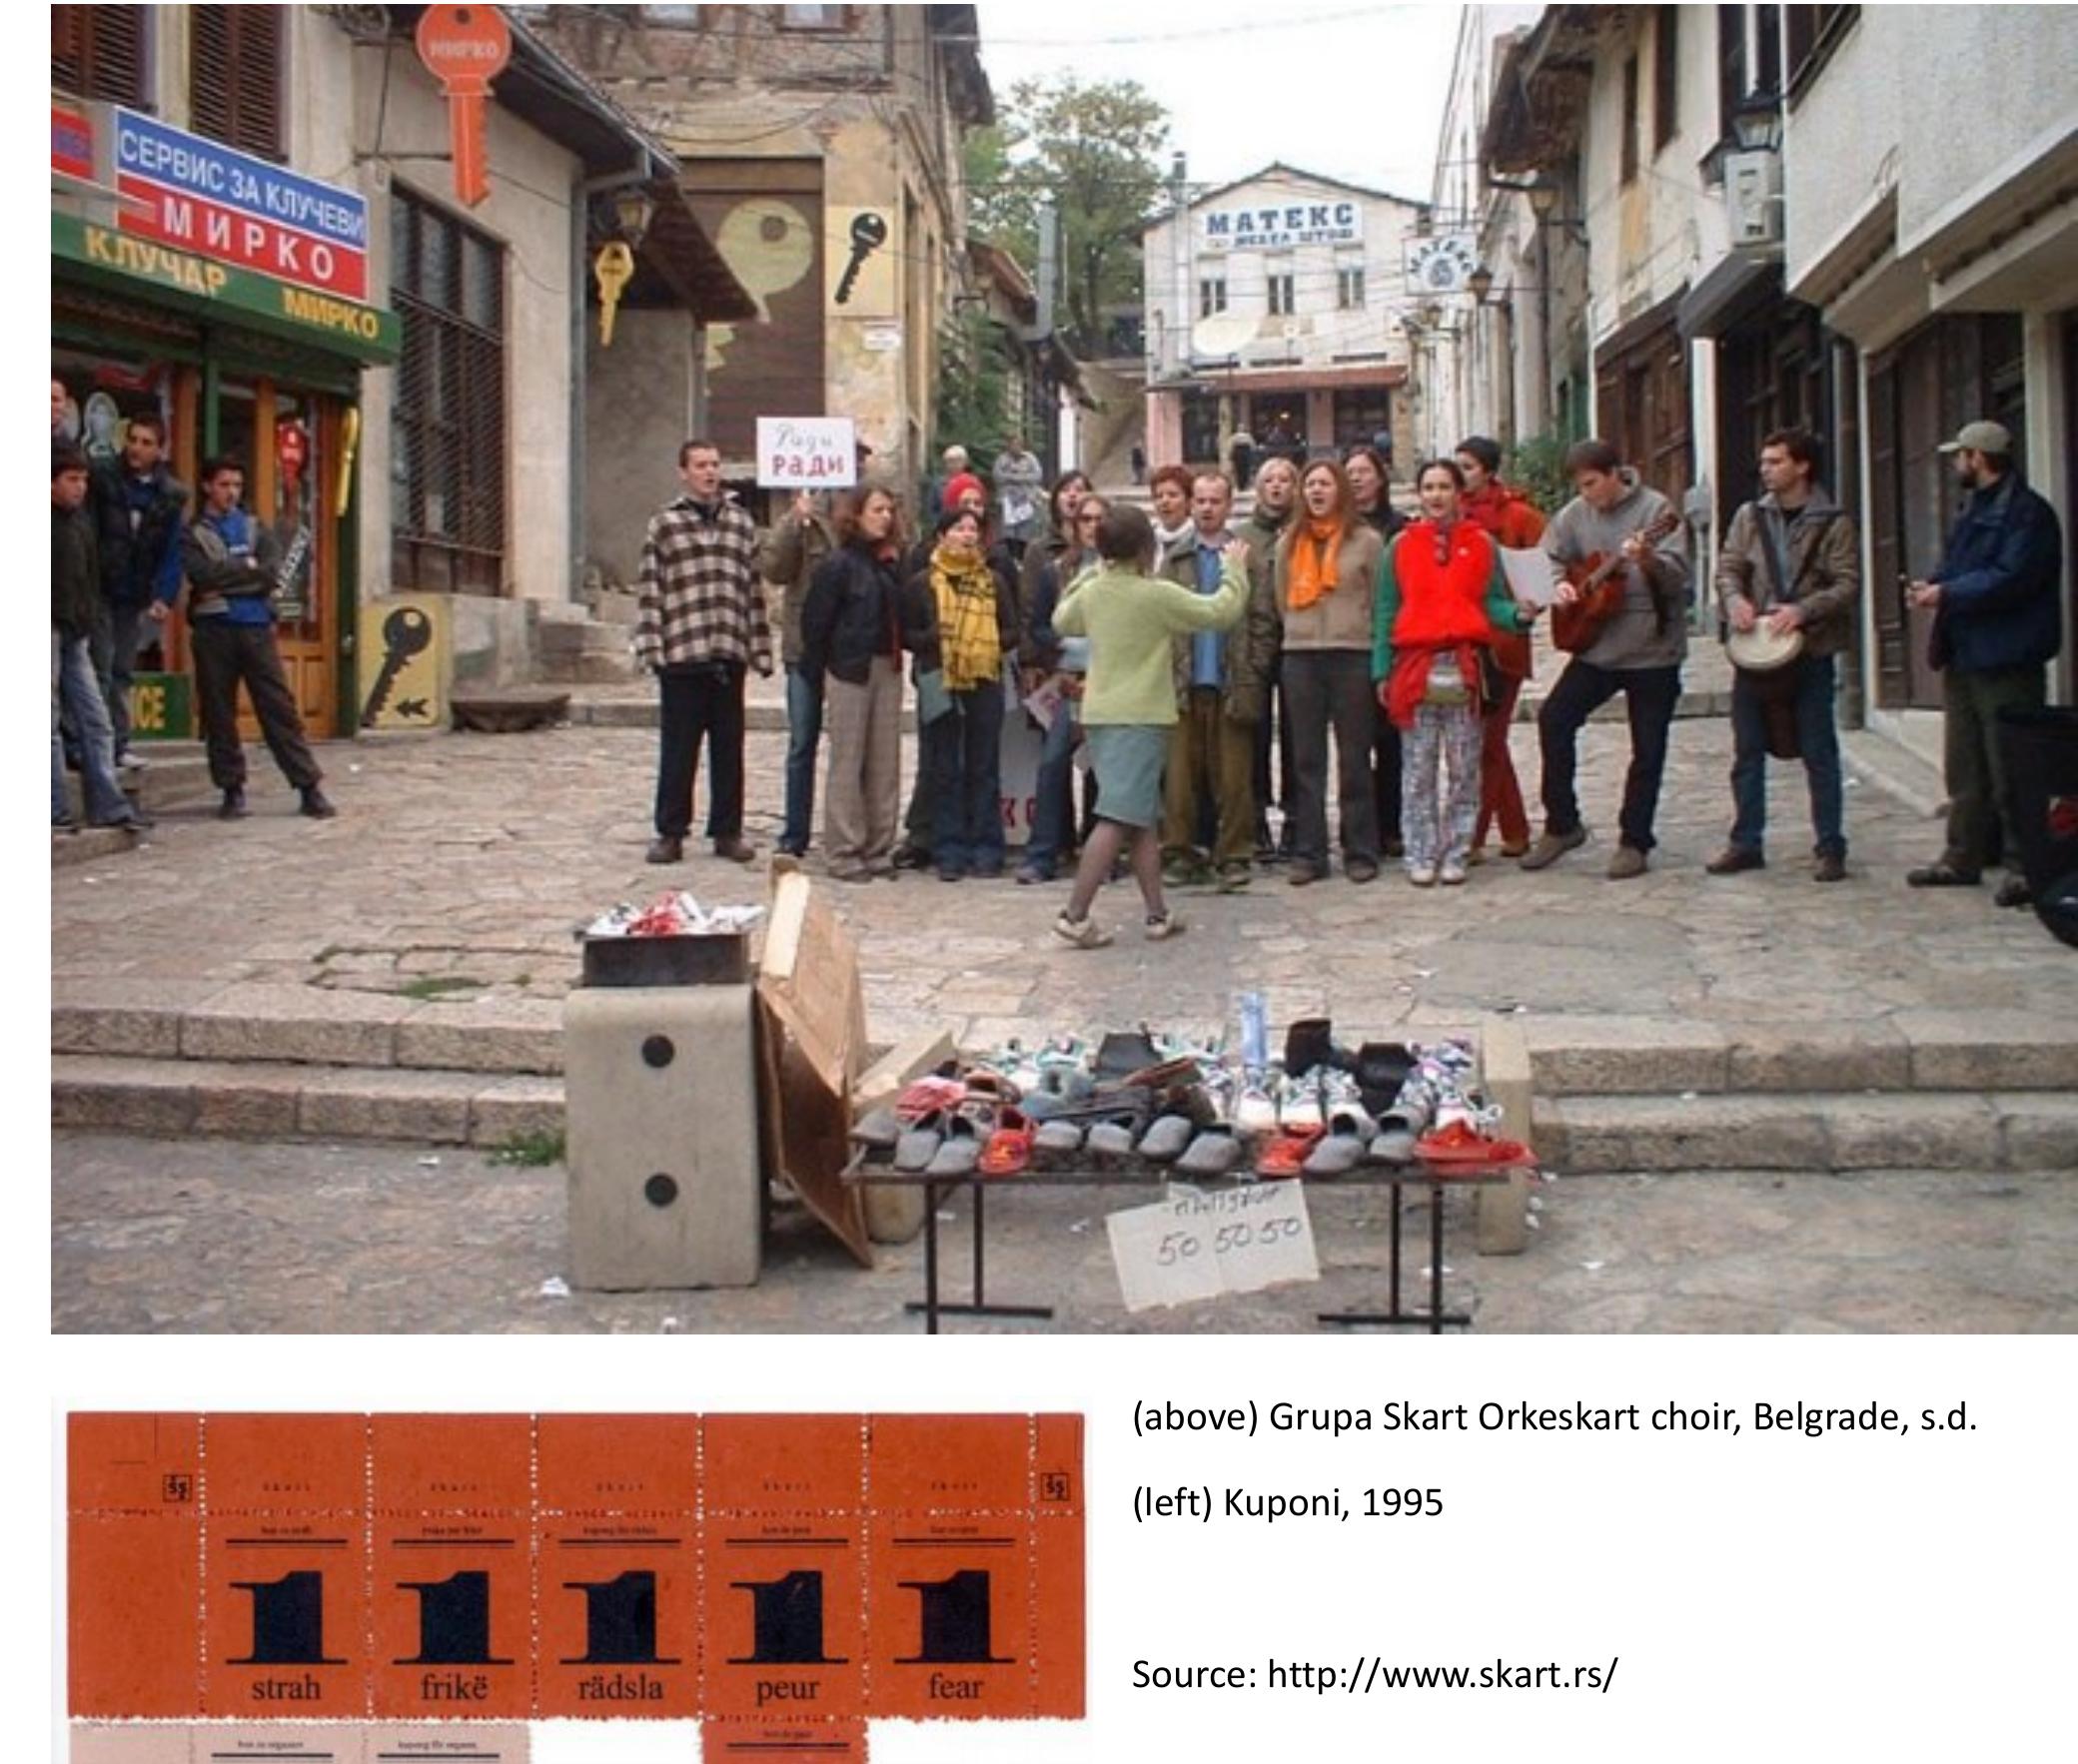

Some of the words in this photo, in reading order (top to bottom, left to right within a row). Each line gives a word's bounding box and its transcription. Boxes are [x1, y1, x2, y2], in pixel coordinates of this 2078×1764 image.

[119, 129, 225, 192] СЕРВИС
[229, 168, 261, 205] ЗА
[265, 181, 365, 240] КЛУЧЕВИ
[1207, 203, 1354, 235] МАТЕКС
[163, 196, 335, 280] МИРКО
[84, 226, 227, 299] КЛУЧАР
[282, 285, 379, 341] МИРКО
[1157, 1231, 1199, 1266] 50
[1215, 1223, 1251, 1254] 50
[1259, 1216, 1302, 1244] 50
[226, 1570, 348, 1665] 1
[393, 1570, 516, 1665] 1
[559, 1569, 682, 1665] 1
[726, 1569, 849, 1665] 1
[893, 1568, 1016, 1665] 1
[252, 1673, 322, 1700] strah
[421, 1673, 488, 1700] frikë
[577, 1673, 664, 1700] rädsla
[756, 1680, 820, 1707] peur
[929, 1673, 984, 1700] fear
